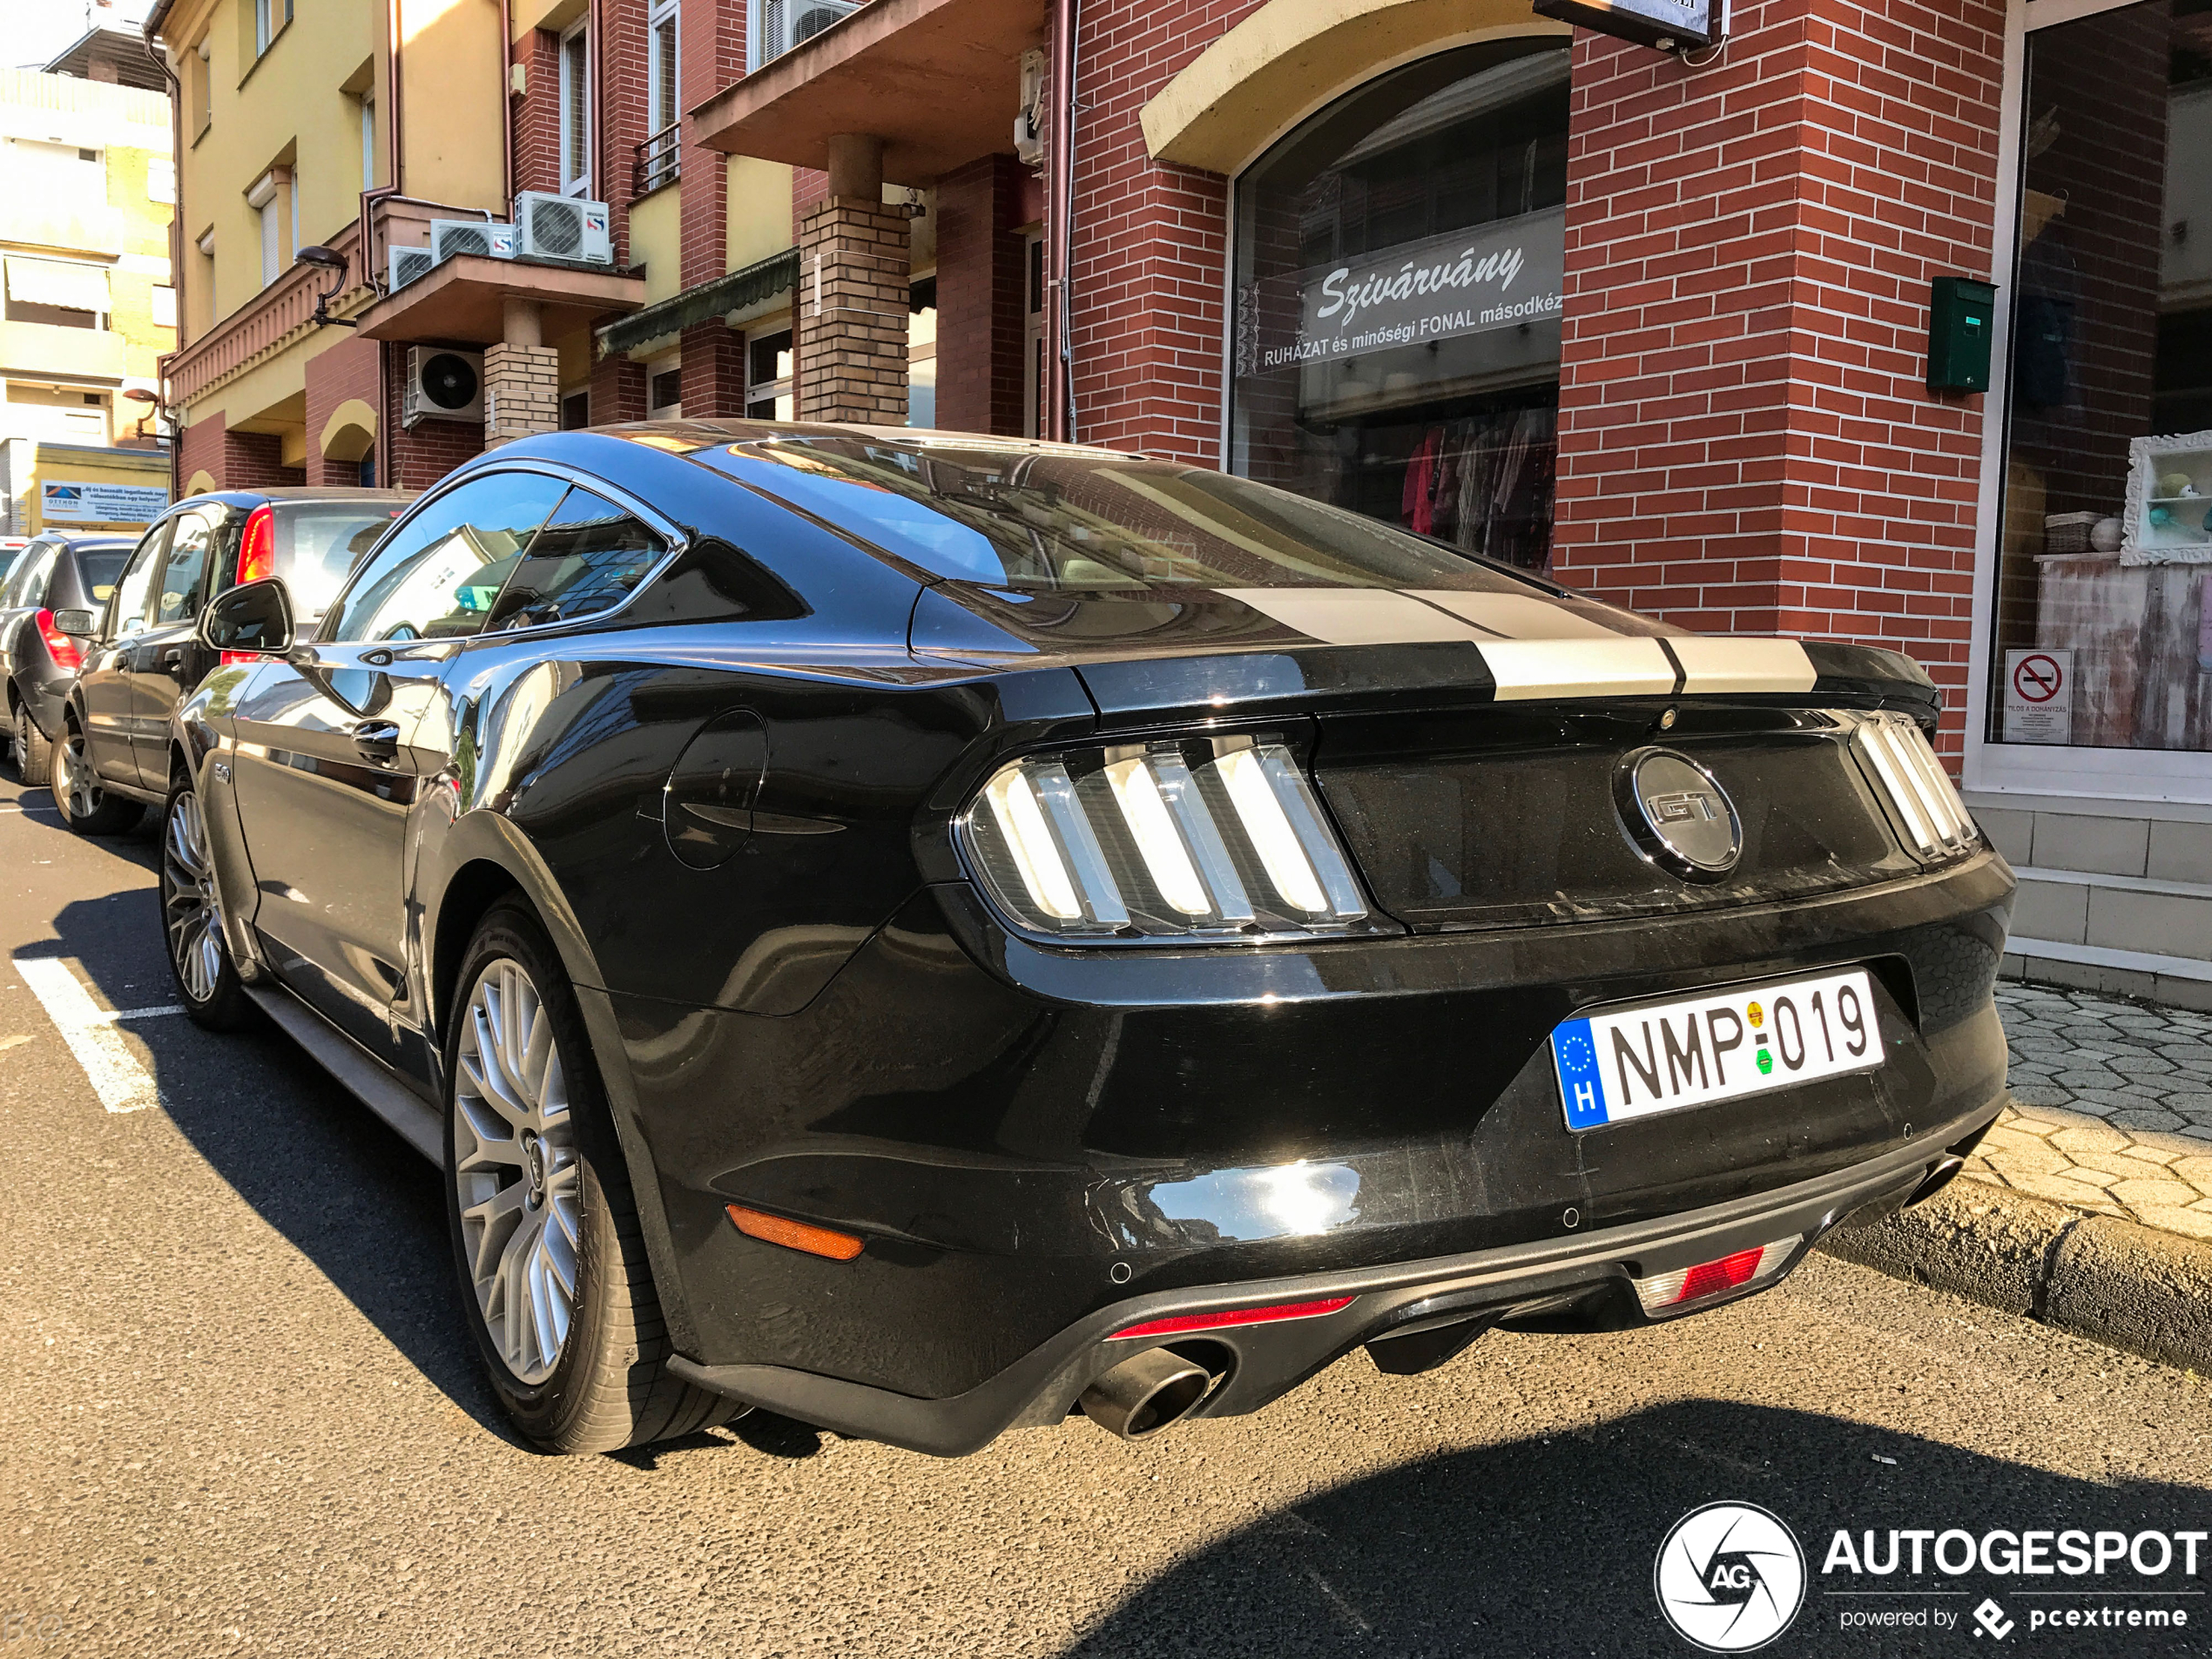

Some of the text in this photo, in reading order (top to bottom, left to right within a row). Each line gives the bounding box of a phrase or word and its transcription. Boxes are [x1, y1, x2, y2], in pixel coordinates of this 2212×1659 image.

[1317, 246, 1524, 327] Szivárvány
[1264, 339, 1328, 367] RUHÁZAT
[1332, 336, 1348, 353] és
[1352, 321, 1416, 350] minőségi
[1420, 309, 1475, 334] FONAL
[1647, 792, 1718, 825] GT
[1574, 1081, 1597, 1112] H
